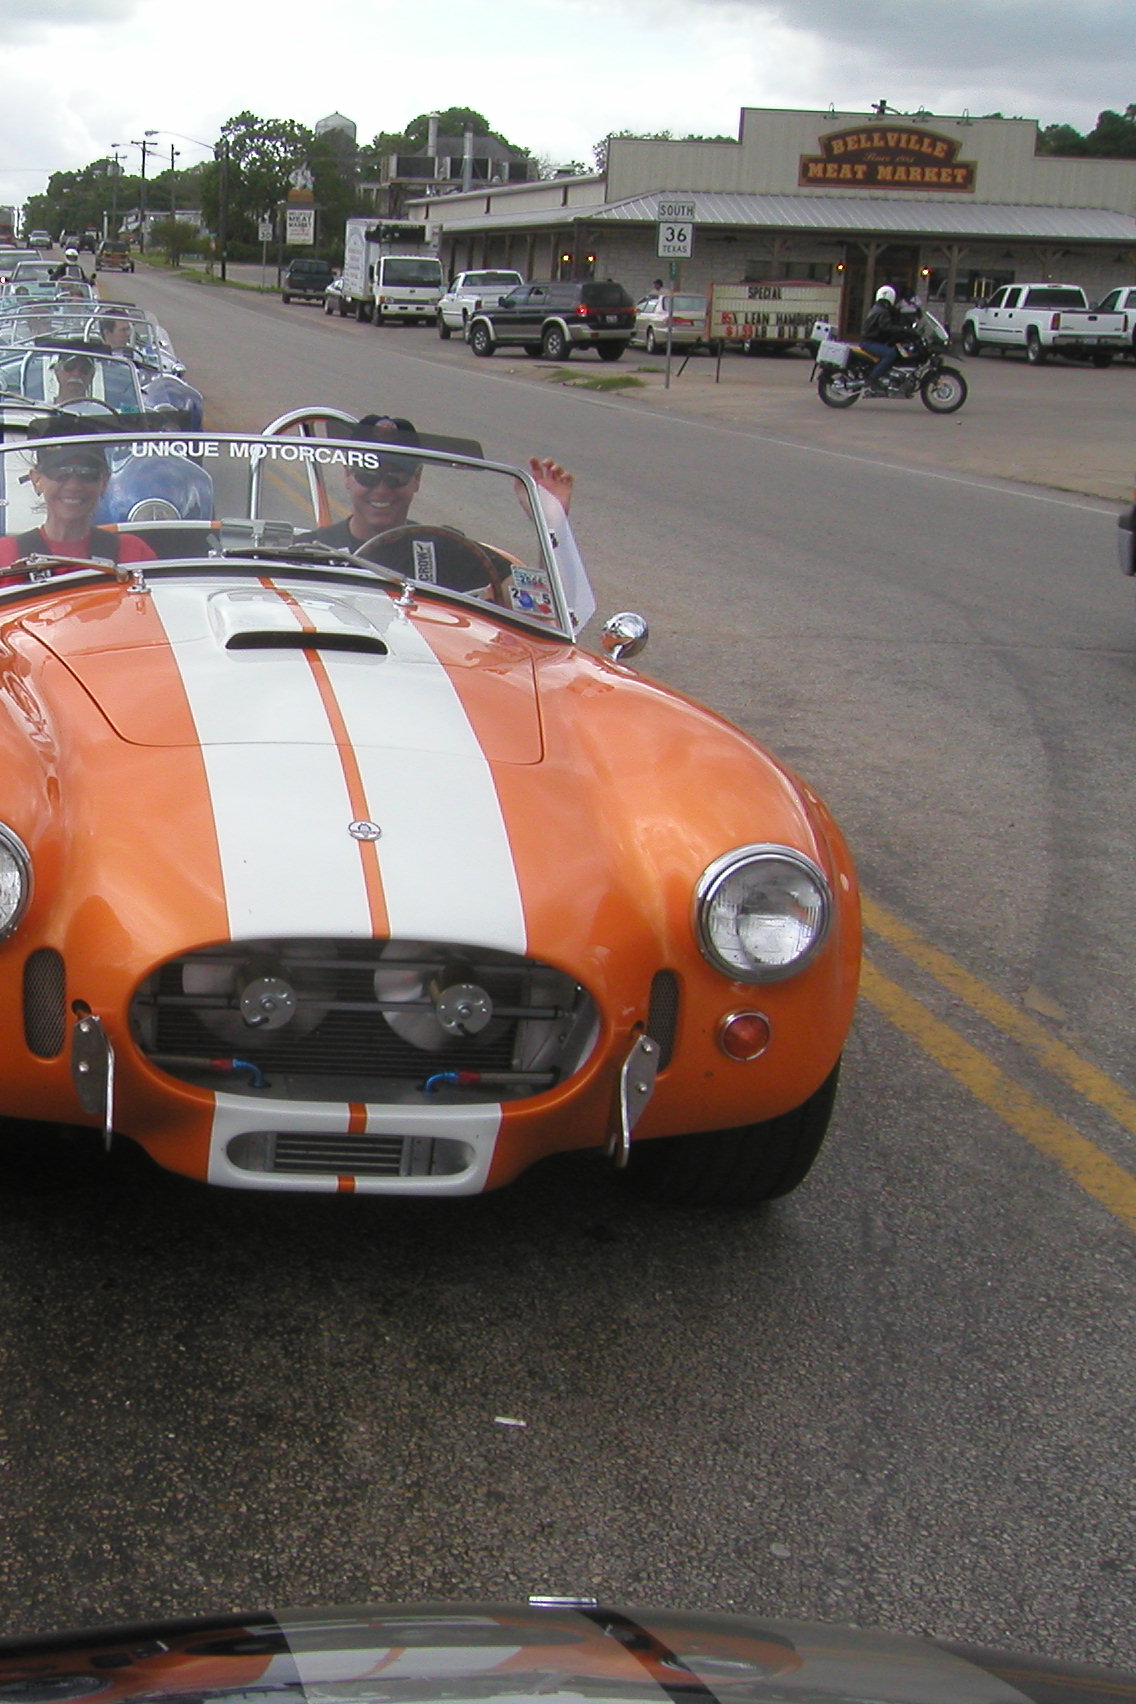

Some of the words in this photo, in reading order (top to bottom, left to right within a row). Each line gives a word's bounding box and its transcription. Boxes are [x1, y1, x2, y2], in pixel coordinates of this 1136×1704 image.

[831, 132, 948, 159] BELLVILLE
[807, 162, 867, 179] MEAT
[877, 165, 968, 184] MARKET
[660, 205, 693, 217] SOUTH
[665, 227, 687, 242] 36
[663, 245, 688, 254] TEXAS
[748, 286, 782, 299] SPECIAL
[744, 312, 770, 325] LEAN
[132, 441, 219, 457] UNIQUE
[230, 442, 380, 469] MOTORCARS
